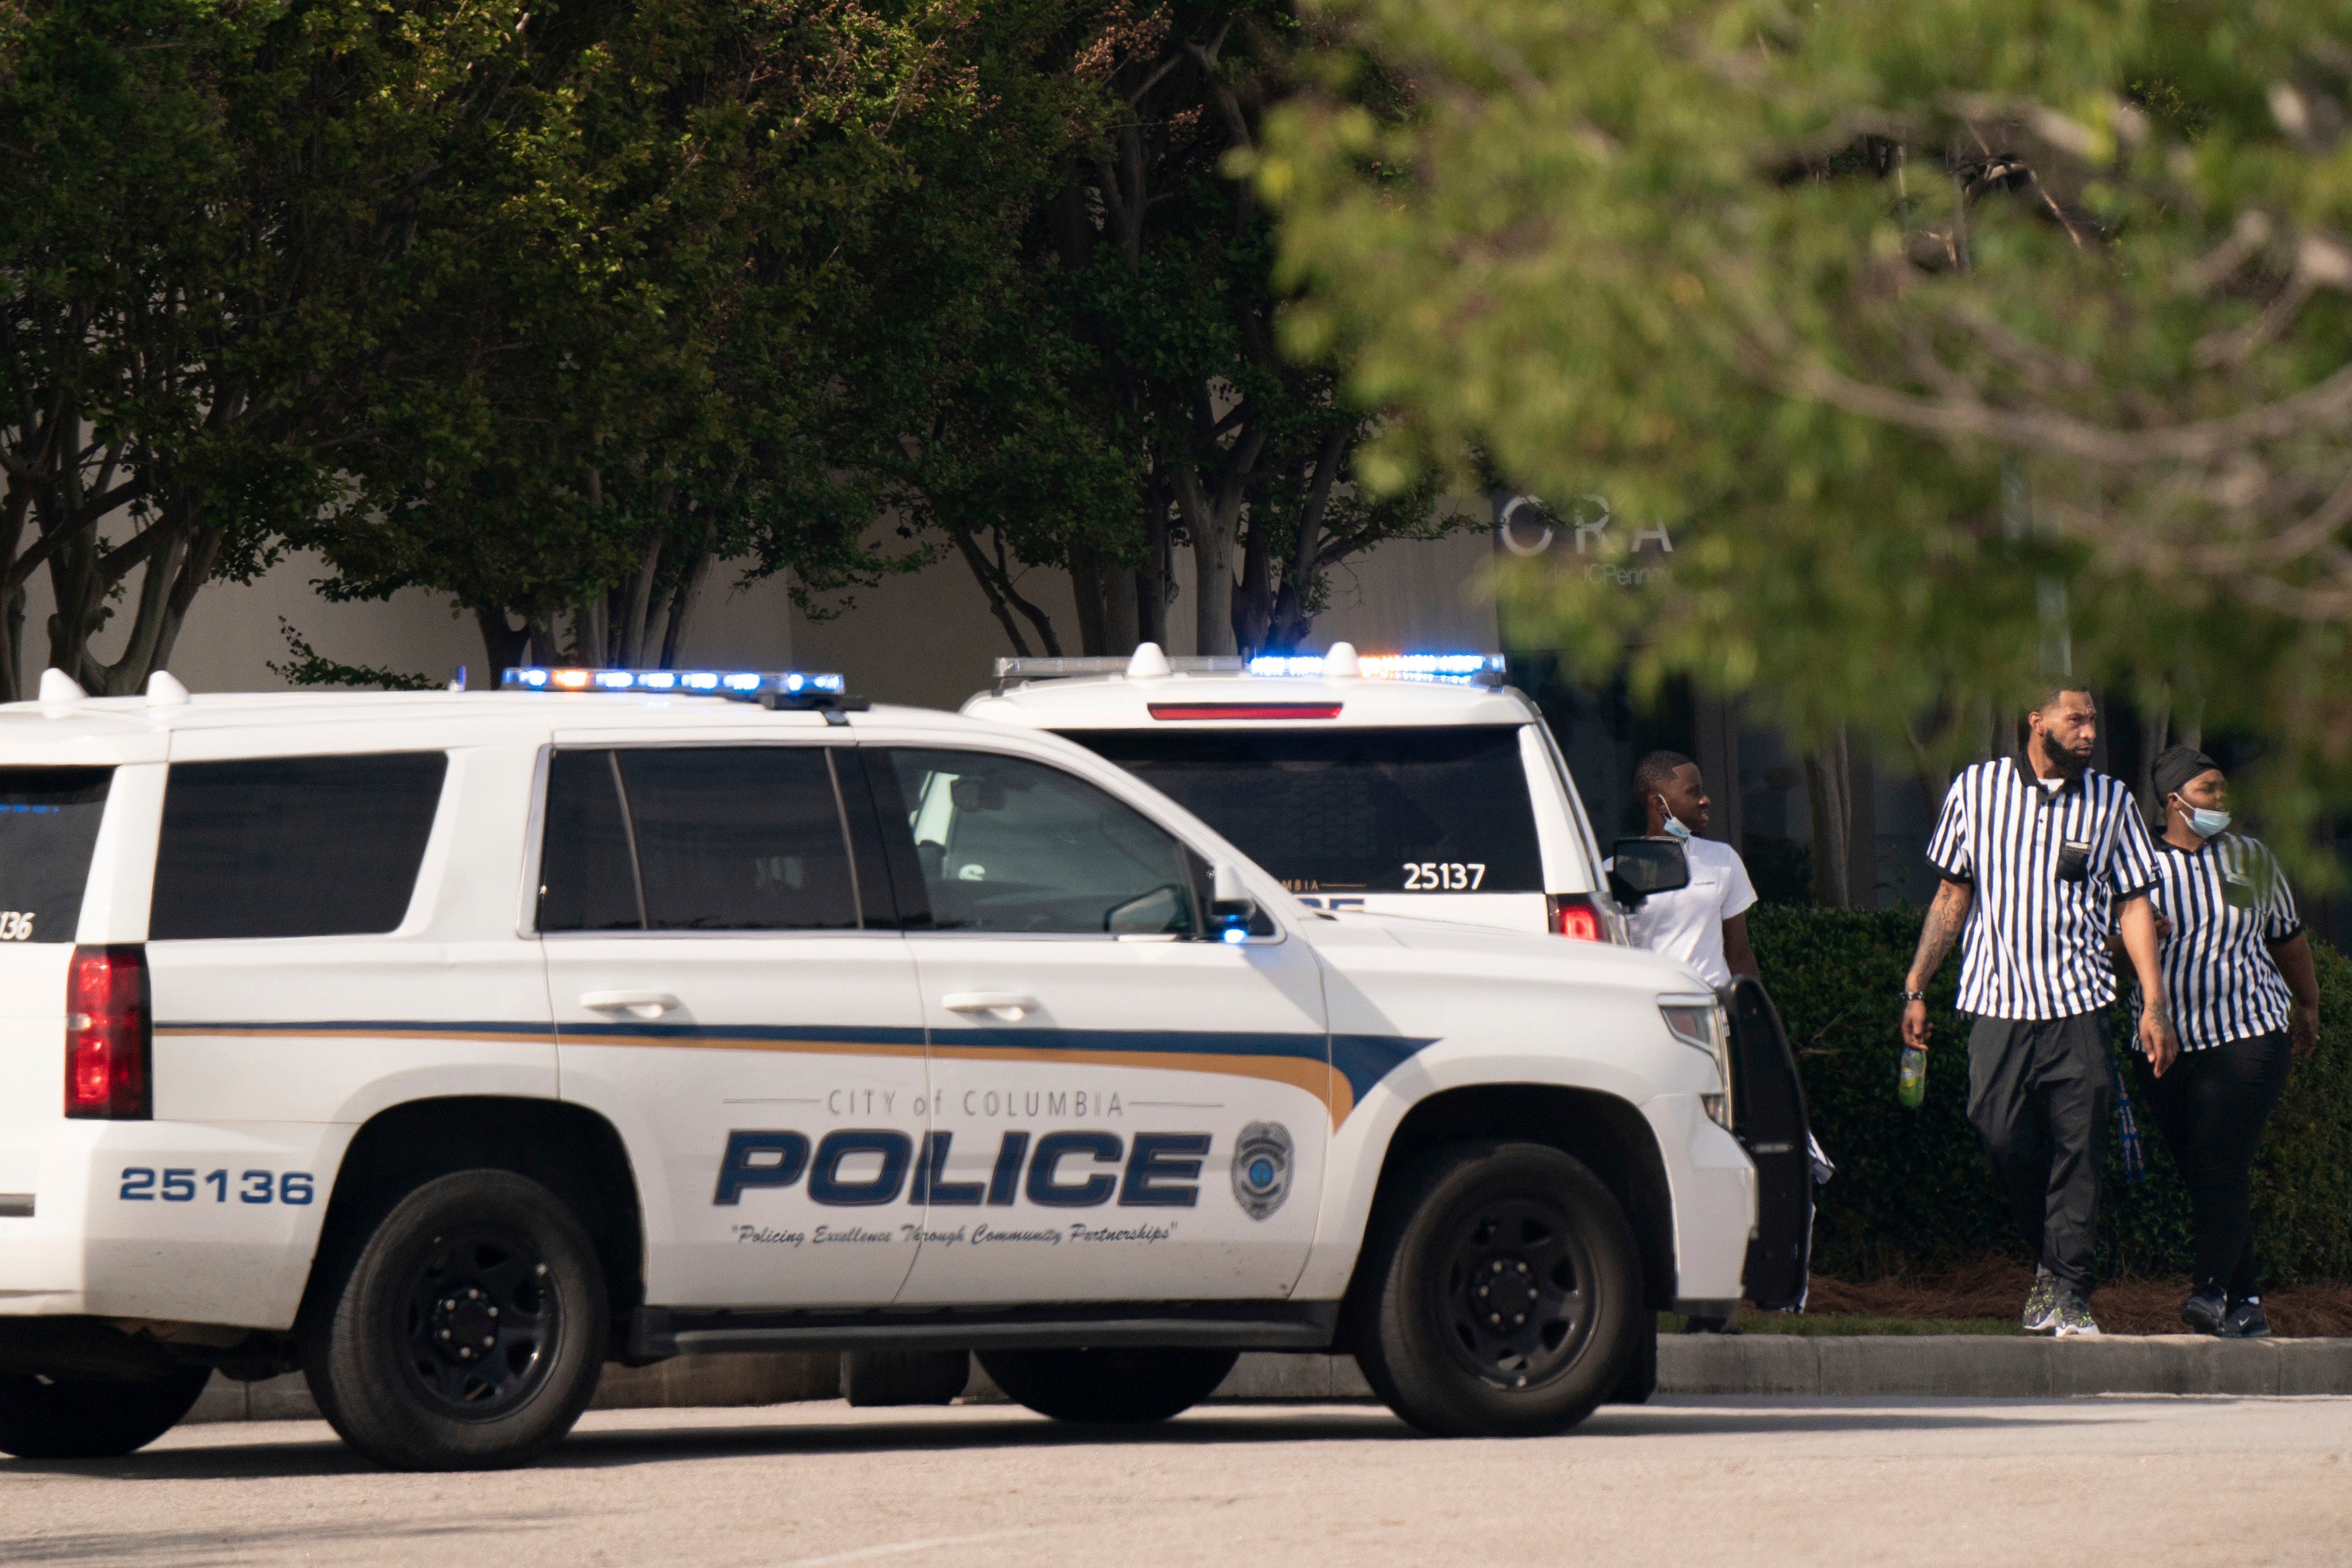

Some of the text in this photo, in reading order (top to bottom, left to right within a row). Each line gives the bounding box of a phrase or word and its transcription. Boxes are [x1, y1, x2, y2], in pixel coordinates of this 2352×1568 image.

[1402, 863, 1485, 890] 25137
[828, 1089, 1124, 1117] CITY of COLUMBIA
[712, 1128, 1212, 1209] POLICE
[119, 1167, 315, 1206] 25136
[812, 1224, 893, 1244] Excellence
[900, 1224, 967, 1247] Through
[971, 1223, 1064, 1246] Community
